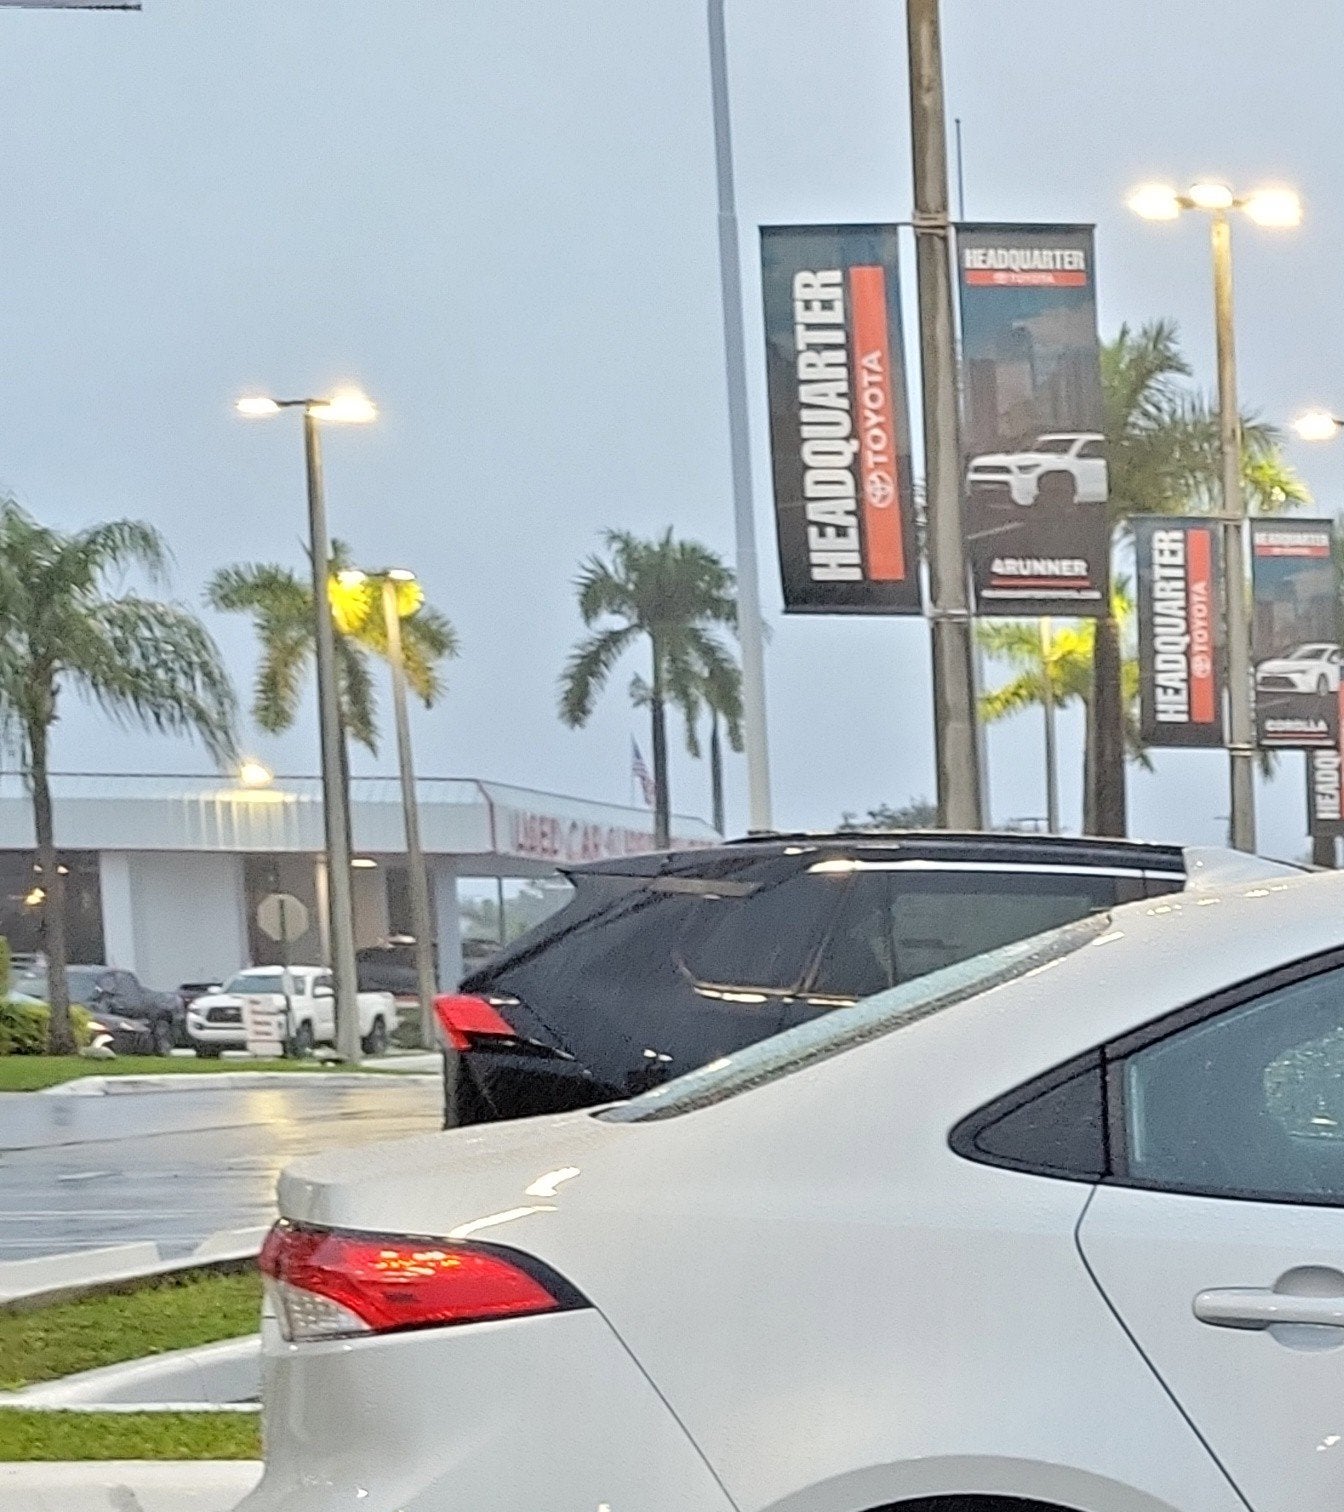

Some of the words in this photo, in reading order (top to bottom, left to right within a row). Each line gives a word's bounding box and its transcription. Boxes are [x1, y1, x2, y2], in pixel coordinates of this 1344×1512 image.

[964, 248, 1086, 271] HEADQUARTER
[793, 267, 863, 583] HEADQUARTER
[861, 349, 889, 470] TOYOTA
[991, 557, 1088, 576] 4RUNNER
[1153, 529, 1189, 722] HEADQUARTER
[1191, 580, 1210, 657] TOYOTA
